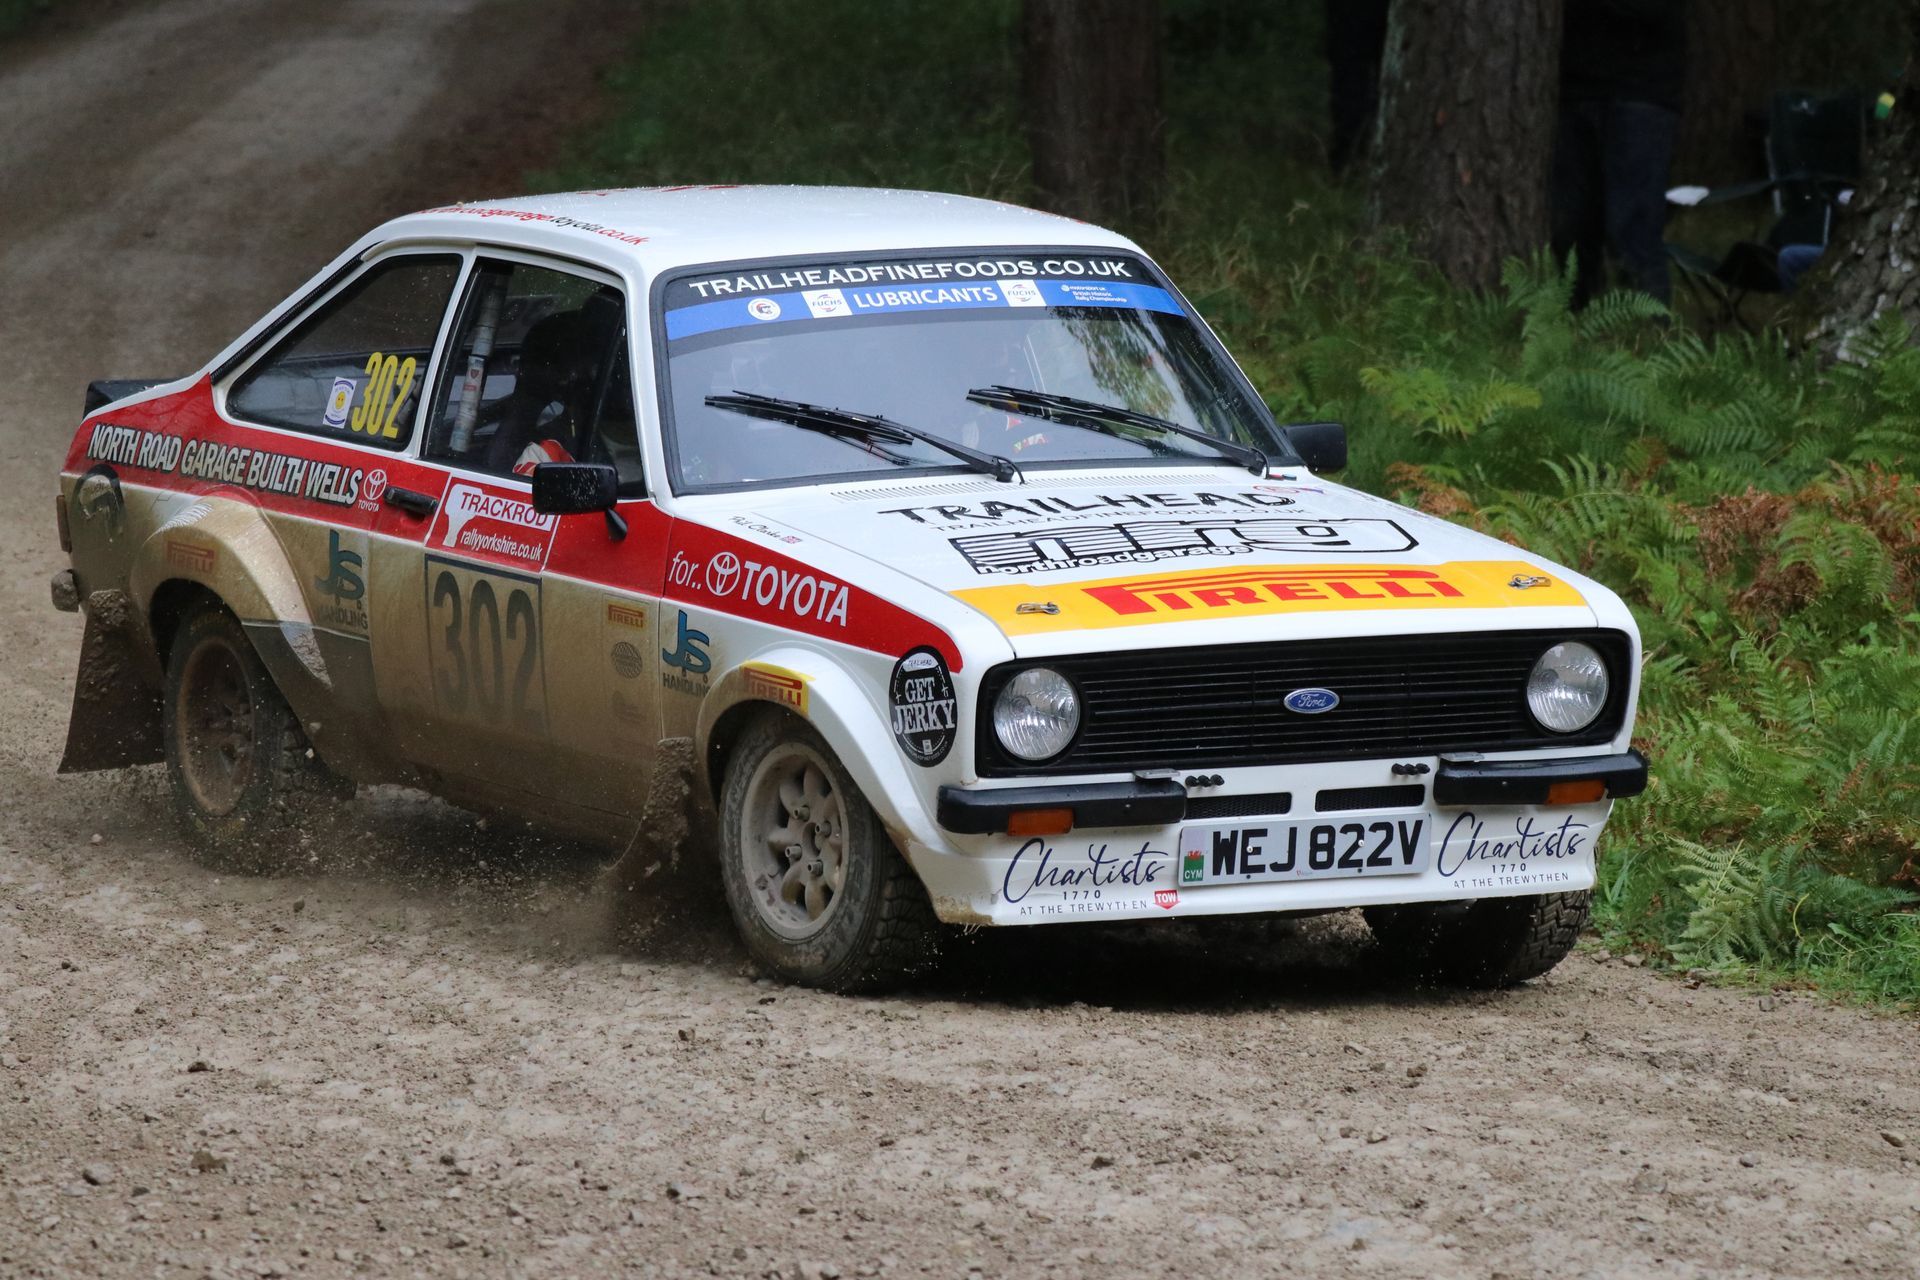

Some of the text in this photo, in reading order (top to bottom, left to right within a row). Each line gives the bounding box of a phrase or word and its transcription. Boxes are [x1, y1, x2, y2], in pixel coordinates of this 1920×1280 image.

[689, 261, 1132, 298] TRAILHEADFINEFOODS.CO.UK
[853, 286, 998, 309] LUBRICANTS
[351, 352, 416, 438] 302
[88, 424, 363, 505] NORTH ROAD GARAGE BUILTH WELLS
[358, 500, 380, 512] TOYOTA
[460, 492, 548, 527] TRACKROD
[877, 492, 1296, 524] TRAILHEAD
[461, 529, 543, 561] rallyyorkshire.co.uk
[978, 544, 1254, 575] northroadgarage
[668, 551, 850, 627] for.. TOYOTA
[1080, 570, 1464, 616] PIRELLI
[608, 604, 644, 629] PIRELLI
[434, 571, 545, 727] 302
[662, 672, 711, 698] HANDLIN
[905, 677, 935, 703] GET
[1297, 693, 1327, 707] Ford
[893, 699, 956, 735] JERKY
[1212, 819, 1424, 876] WEJ 822V
[1437, 812, 1589, 877] Chartists
[1003, 838, 1168, 903] Chartists
[1184, 870, 1203, 880] CYM
[1453, 872, 1569, 889] AT THE TREWYTHEN
[1491, 862, 1527, 873] 1770
[1020, 906, 1033, 915] AT
[1039, 904, 1063, 914] THE
[1063, 889, 1101, 900] 1770
[1155, 891, 1176, 904] TOW
